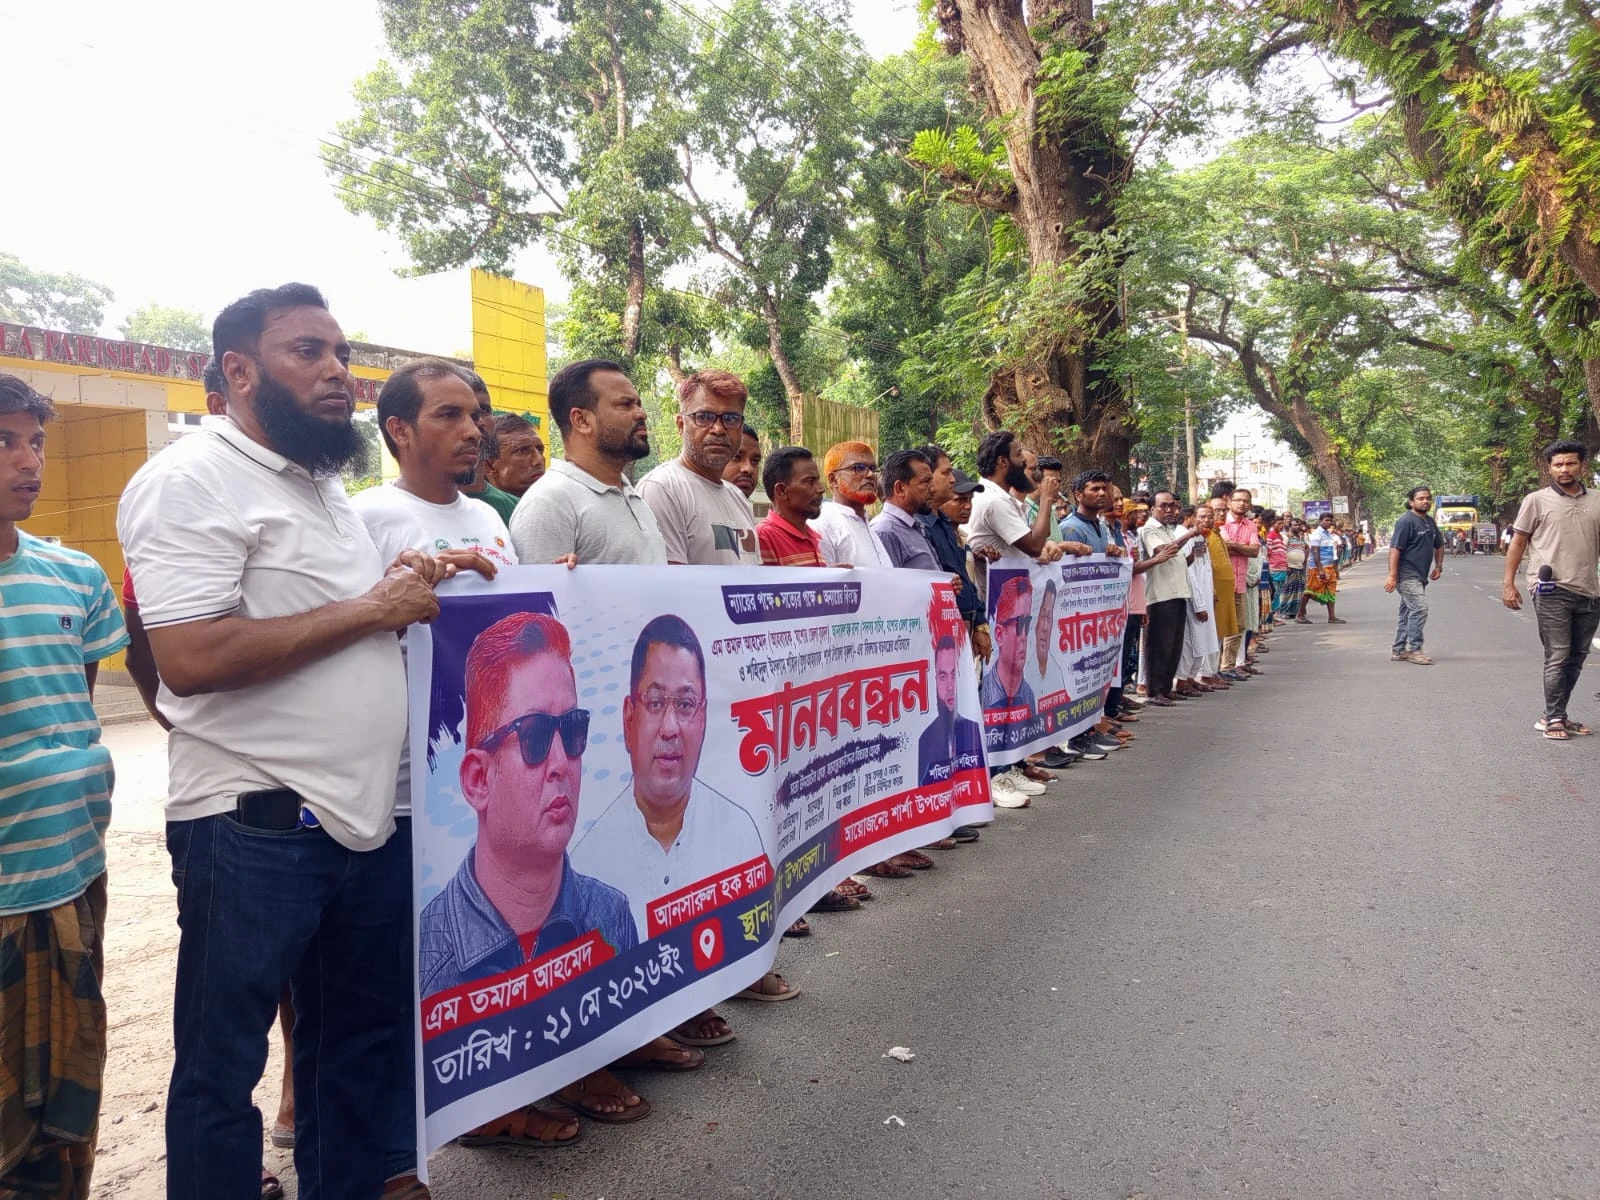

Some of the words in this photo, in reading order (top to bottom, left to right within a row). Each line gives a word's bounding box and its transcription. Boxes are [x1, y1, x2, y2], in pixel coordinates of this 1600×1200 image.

[44, 329, 171, 374] PARISHAD
[728, 592, 759, 614] ন্যায়ের
[757, 592, 775, 611] পক্ষে
[780, 591, 801, 609] সত্যের
[802, 590, 817, 608] পক্ষে
[822, 589, 843, 607] অন্যায়ের
[712, 640, 723, 657] এম
[723, 637, 744, 655] তমাল
[742, 634, 767, 654] আহমেদ
[739, 666, 746, 682] ও
[730, 659, 930, 778] মানববন্ধন
[1010, 730, 1019, 745] ২১
[891, 794, 913, 823] শার্শা
[653, 883, 717, 928] আনসারুল
[720, 873, 744, 899] হক
[745, 861, 767, 889] রানা
[737, 899, 773, 943] স্থান:
[785, 843, 822, 889] উপজেলা
[426, 997, 462, 1031] এম
[468, 973, 529, 1014] তমাল
[533, 940, 594, 990] আহমেদ
[432, 1025, 517, 1084] তারিখ
[543, 1006, 572, 1045] ২১
[579, 986, 602, 1026] মে
[607, 943, 685, 1009] ২০২৬ইং
